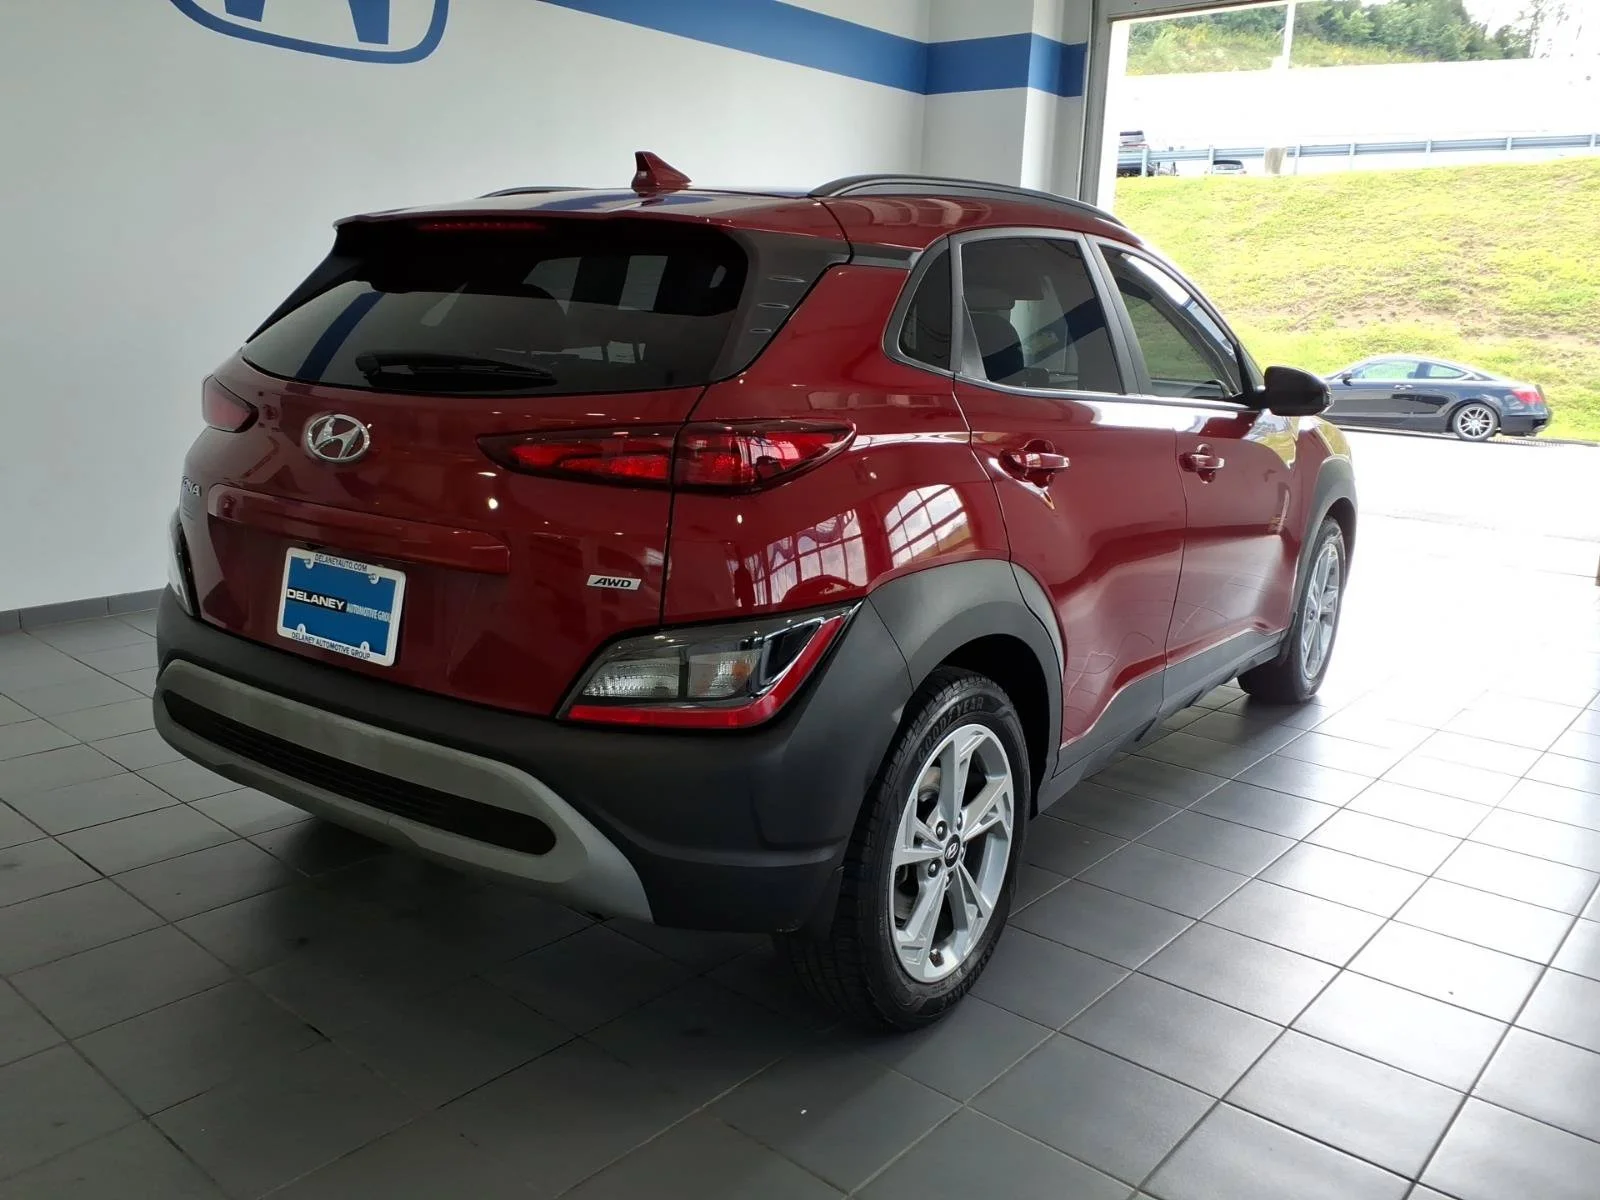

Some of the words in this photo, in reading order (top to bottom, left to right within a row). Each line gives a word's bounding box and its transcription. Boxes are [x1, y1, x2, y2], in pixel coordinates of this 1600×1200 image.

[314, 553, 368, 572] DELANEYAUTO.COM
[594, 577, 632, 588] AWD
[286, 588, 345, 610] DELANEY
[346, 603, 378, 620] AUTOMOTIVE
[377, 609, 391, 622] GROU
[291, 631, 315, 646] DELANEY
[315, 638, 350, 655] AUTOMOTIVE
[350, 648, 371, 660] GROUP
[917, 696, 985, 763] GOODYEAR
